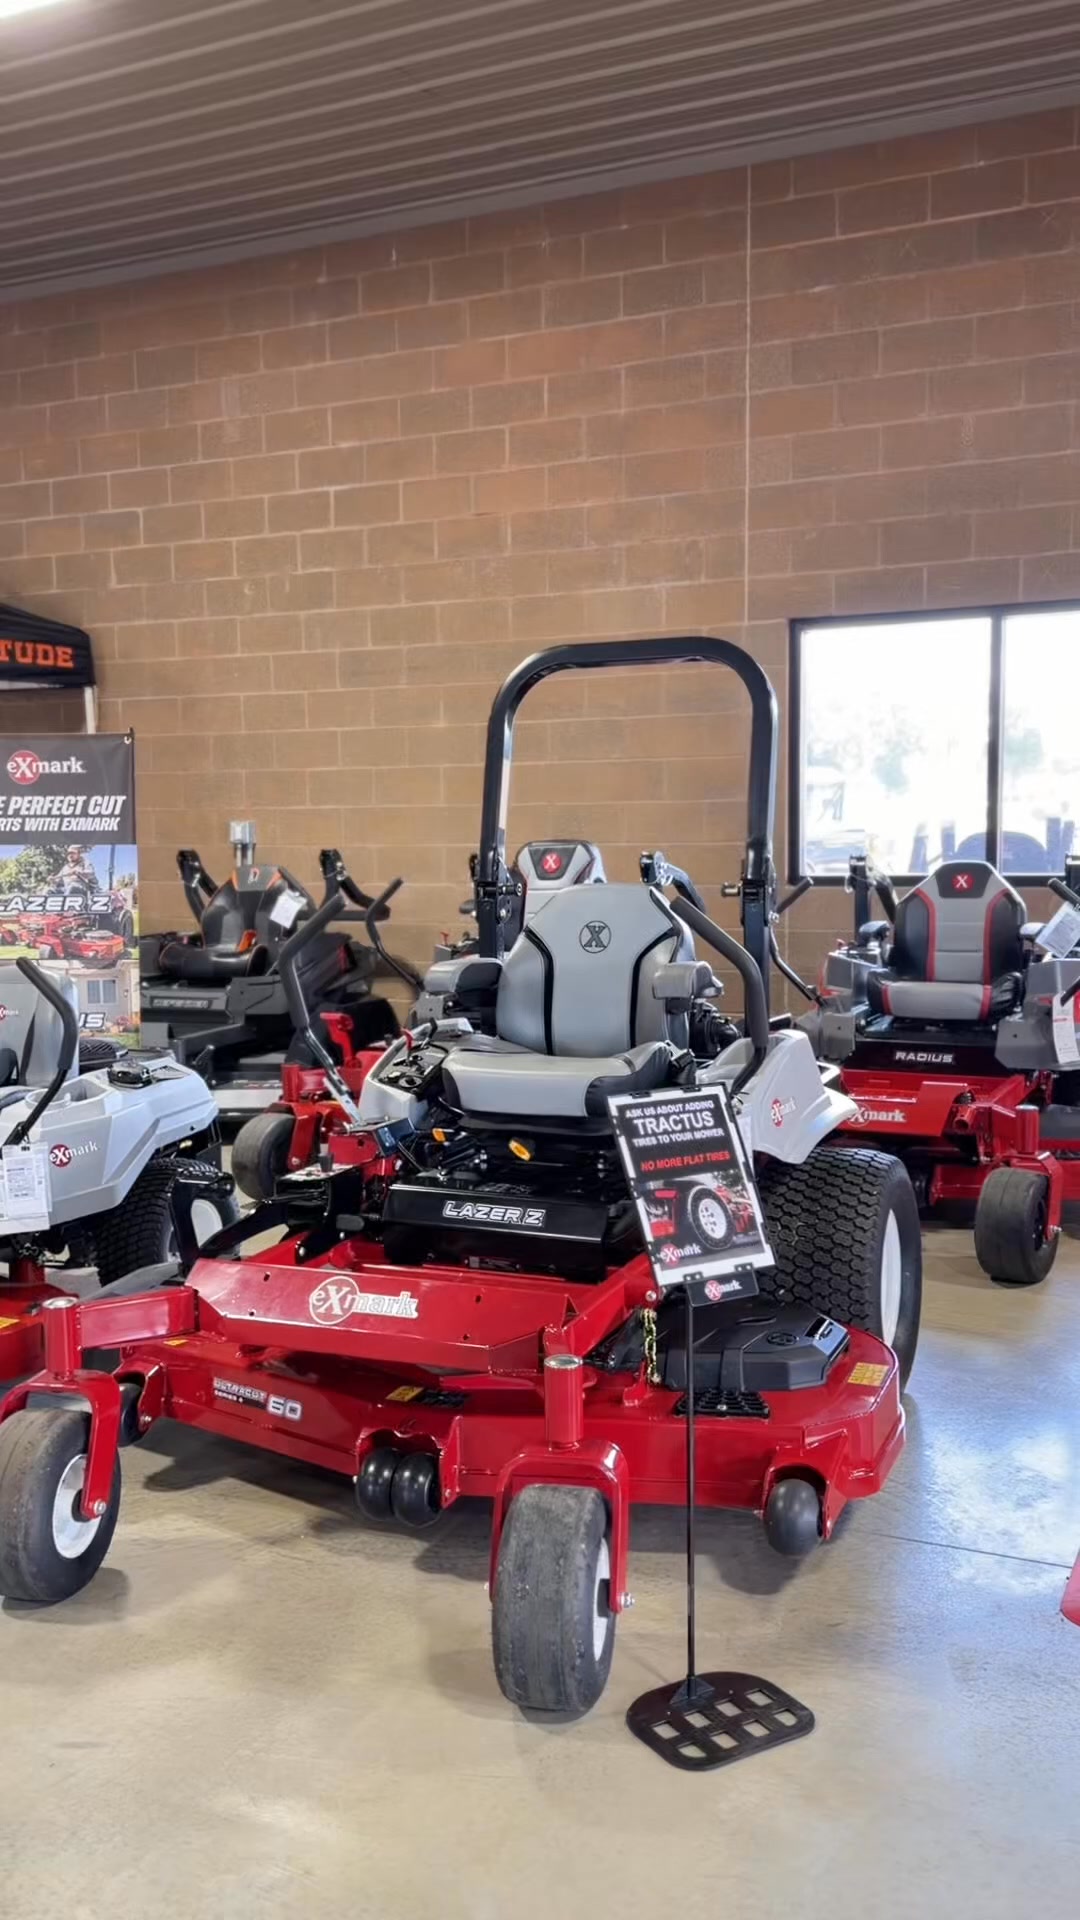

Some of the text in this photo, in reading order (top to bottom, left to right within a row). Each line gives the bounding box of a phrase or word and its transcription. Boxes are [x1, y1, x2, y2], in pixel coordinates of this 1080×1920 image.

[6, 755, 85, 779] eXmark
[7, 796, 87, 815] PERFECT
[88, 796, 126, 815] CUT
[24, 817, 60, 831] WITH
[61, 817, 120, 832] EXMARK
[91, 895, 110, 911] Z
[895, 1051, 953, 1063] RADIUS
[626, 1100, 714, 1118] ASK US ABOUT ADDING
[633, 1111, 714, 1135] TRACTUS
[632, 1127, 725, 1147] TIRES TO YOUR MOWER
[50, 1141, 98, 1165] eXmark
[641, 1151, 730, 1171] NO MORE FLAT TIRES
[444, 1202, 544, 1225] LAZER Z
[311, 1283, 416, 1318] eXmark
